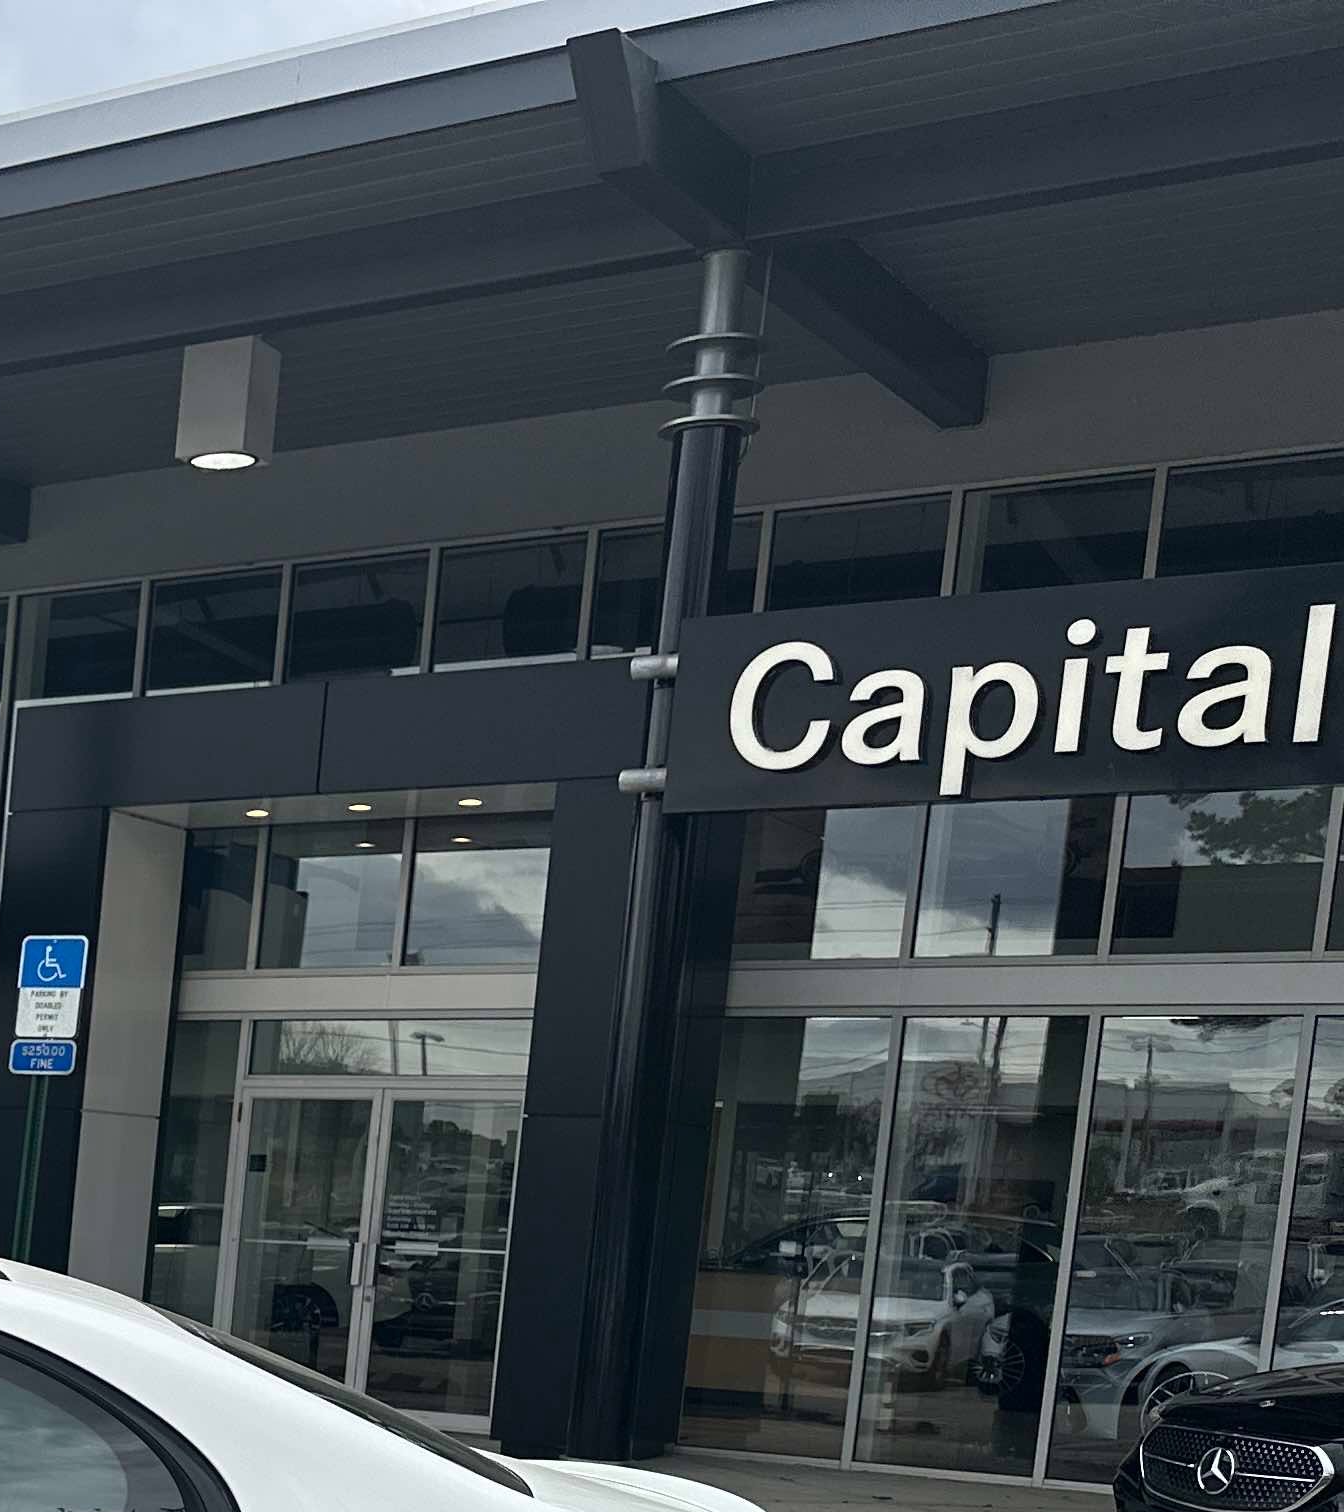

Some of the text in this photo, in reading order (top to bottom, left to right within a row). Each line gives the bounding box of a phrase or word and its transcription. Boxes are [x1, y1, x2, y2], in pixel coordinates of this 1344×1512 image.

[728, 603, 1337, 796] Capital
[35, 1013, 59, 1021] PERMIT
[30, 1058, 54, 1069] FINE
